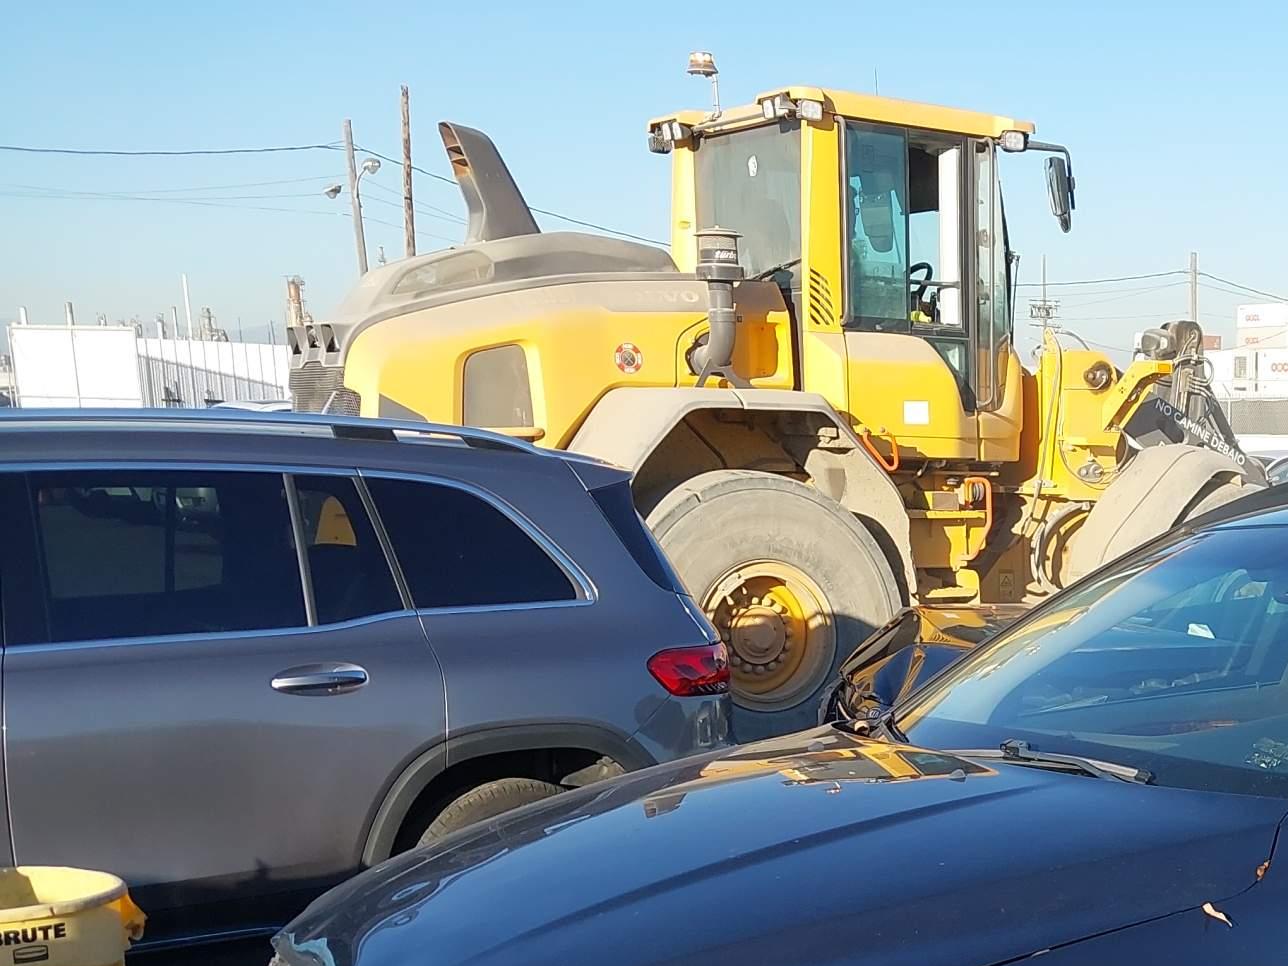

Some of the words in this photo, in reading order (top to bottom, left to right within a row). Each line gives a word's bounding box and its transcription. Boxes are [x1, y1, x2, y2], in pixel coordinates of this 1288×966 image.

[1155, 400, 1172, 416] NO
[1173, 411, 1210, 443] CAMINE
[0, 922, 66, 946] RUTE
